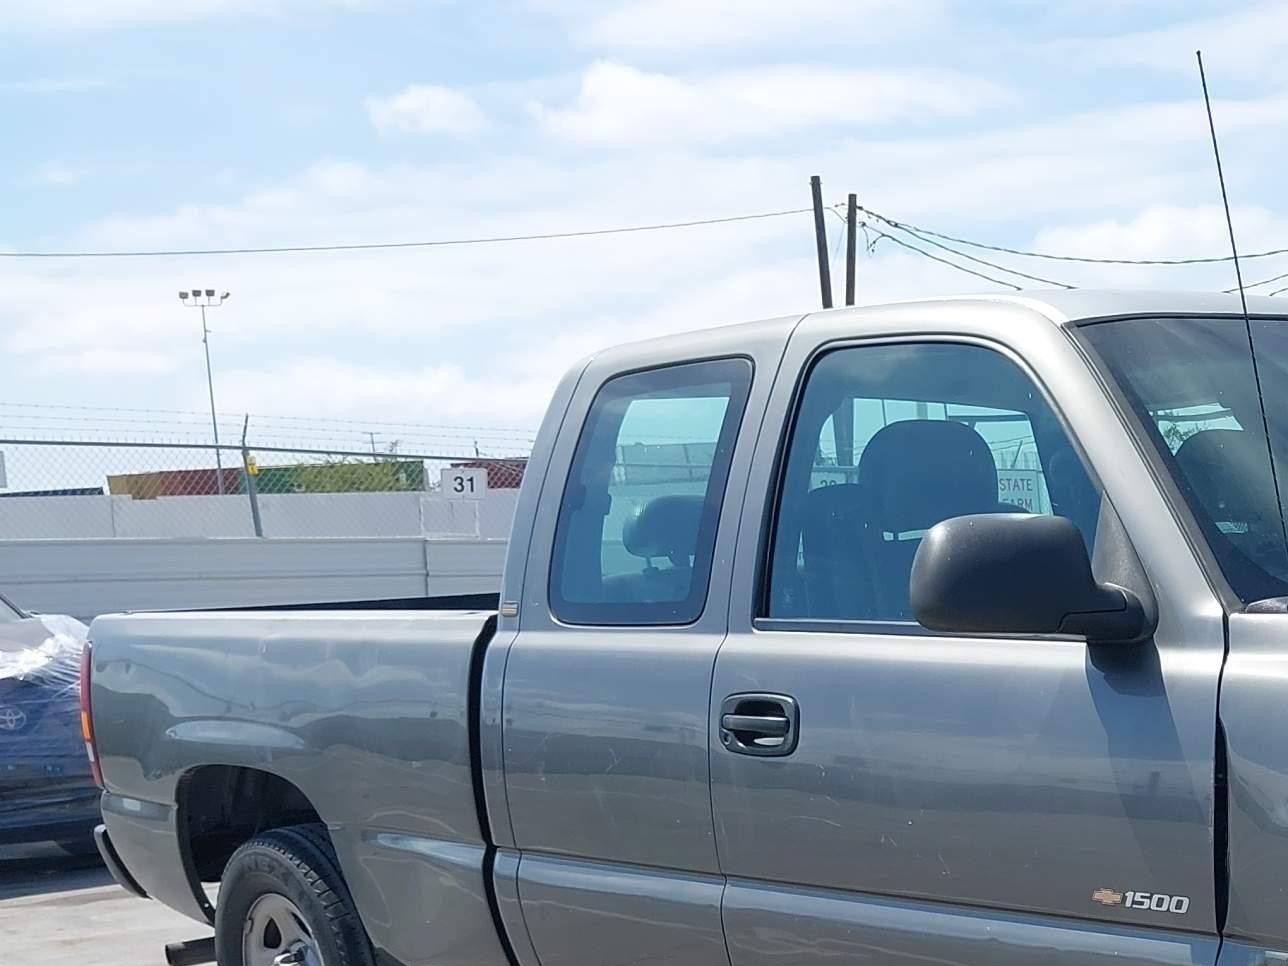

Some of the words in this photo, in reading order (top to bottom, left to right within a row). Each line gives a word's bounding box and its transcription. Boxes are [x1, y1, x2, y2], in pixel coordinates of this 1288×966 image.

[454, 476, 474, 493] 31
[999, 479, 1033, 491] STATE
[1125, 891, 1190, 914] 1500
